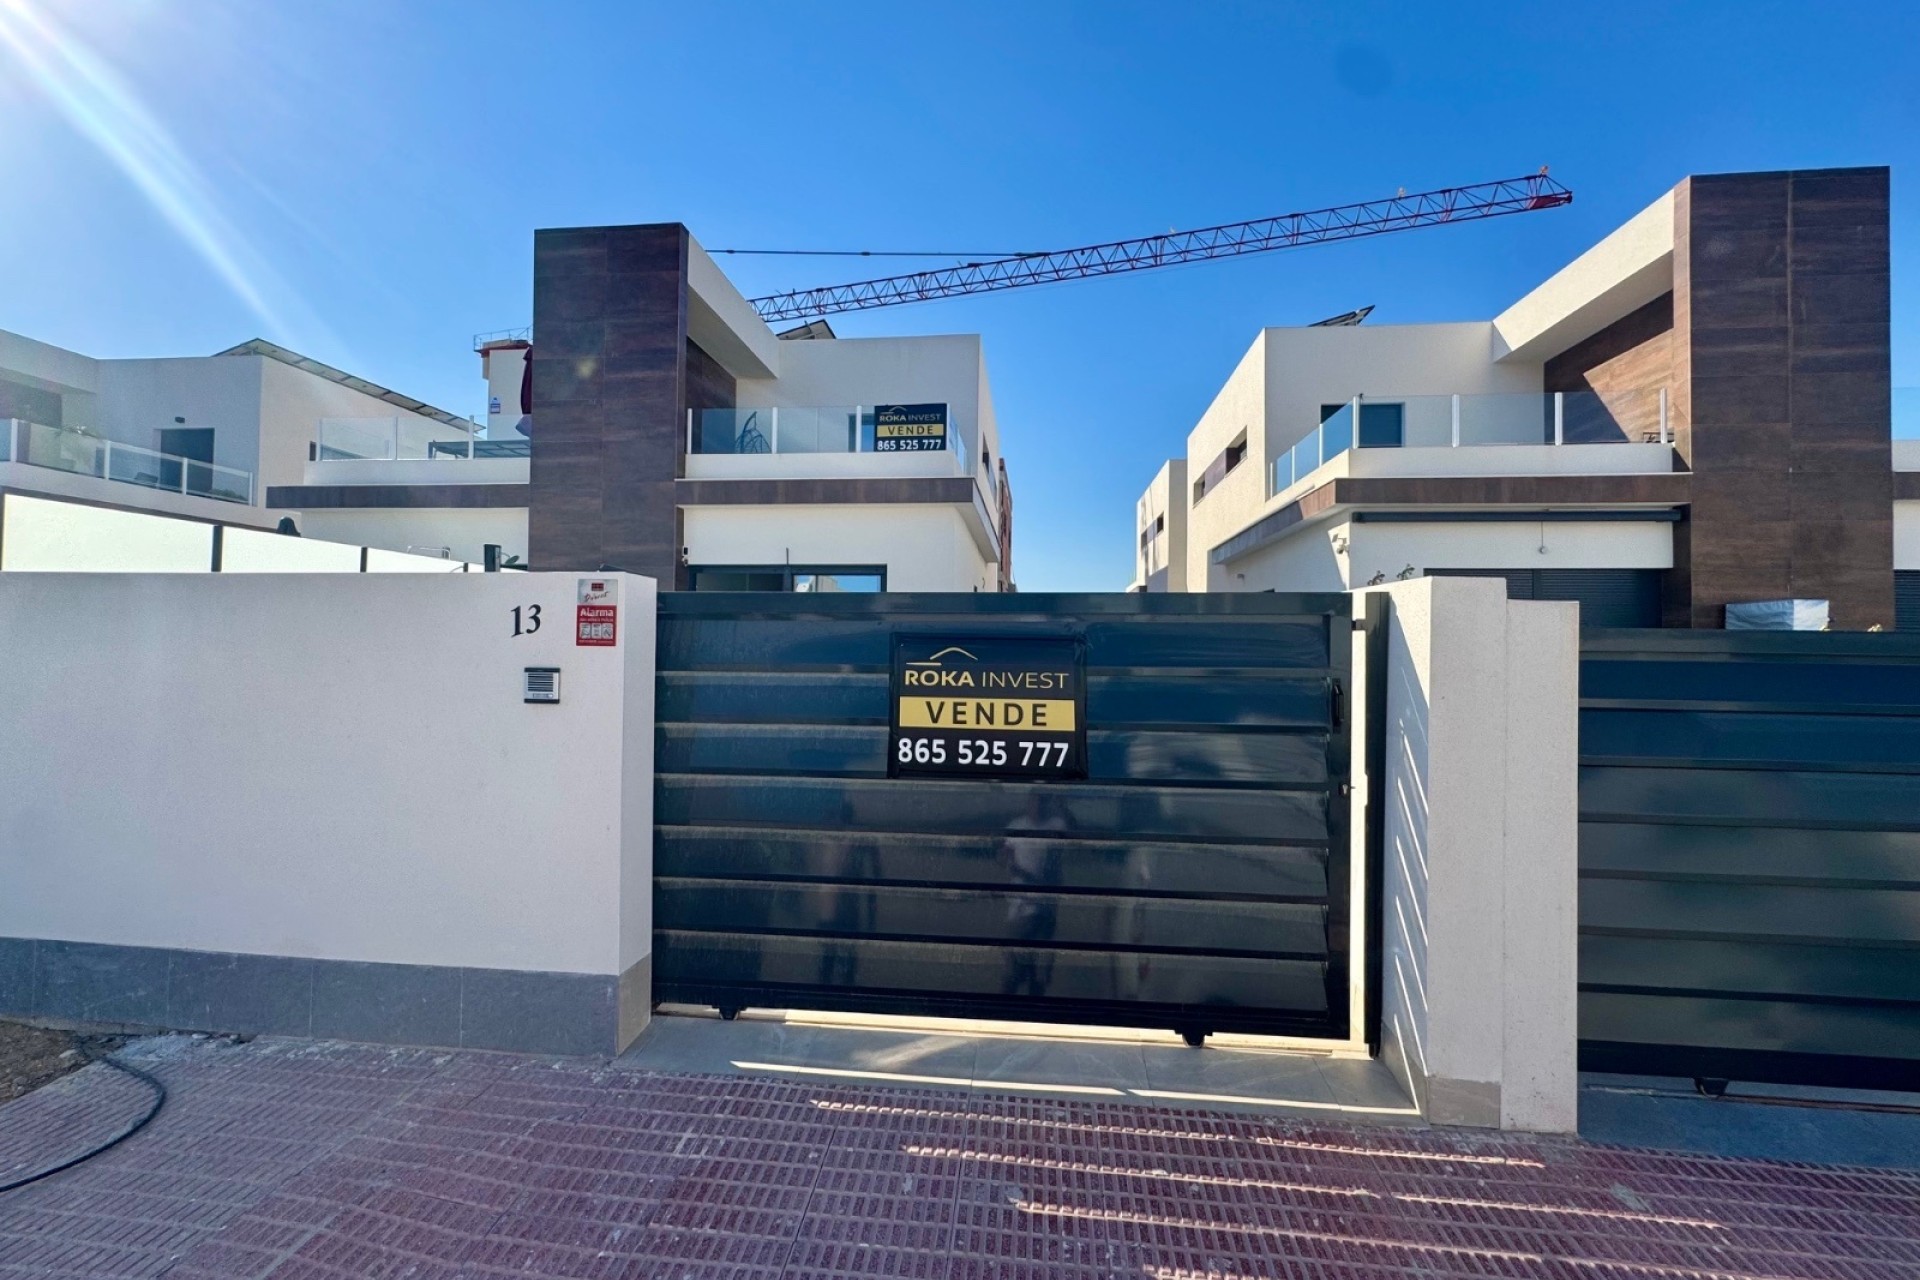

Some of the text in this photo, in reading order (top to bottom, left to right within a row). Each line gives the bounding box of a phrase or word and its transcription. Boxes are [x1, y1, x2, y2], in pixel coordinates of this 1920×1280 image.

[908, 413, 941, 421] INVEST
[888, 425, 934, 436] VENDE
[877, 439, 941, 451] 865 525 777
[580, 607, 614, 617] Alarma
[510, 603, 542, 638] 13
[904, 670, 1070, 689] ROKA INVEST
[925, 701, 1048, 727] VENDE
[898, 738, 1069, 767] 865 525 777
